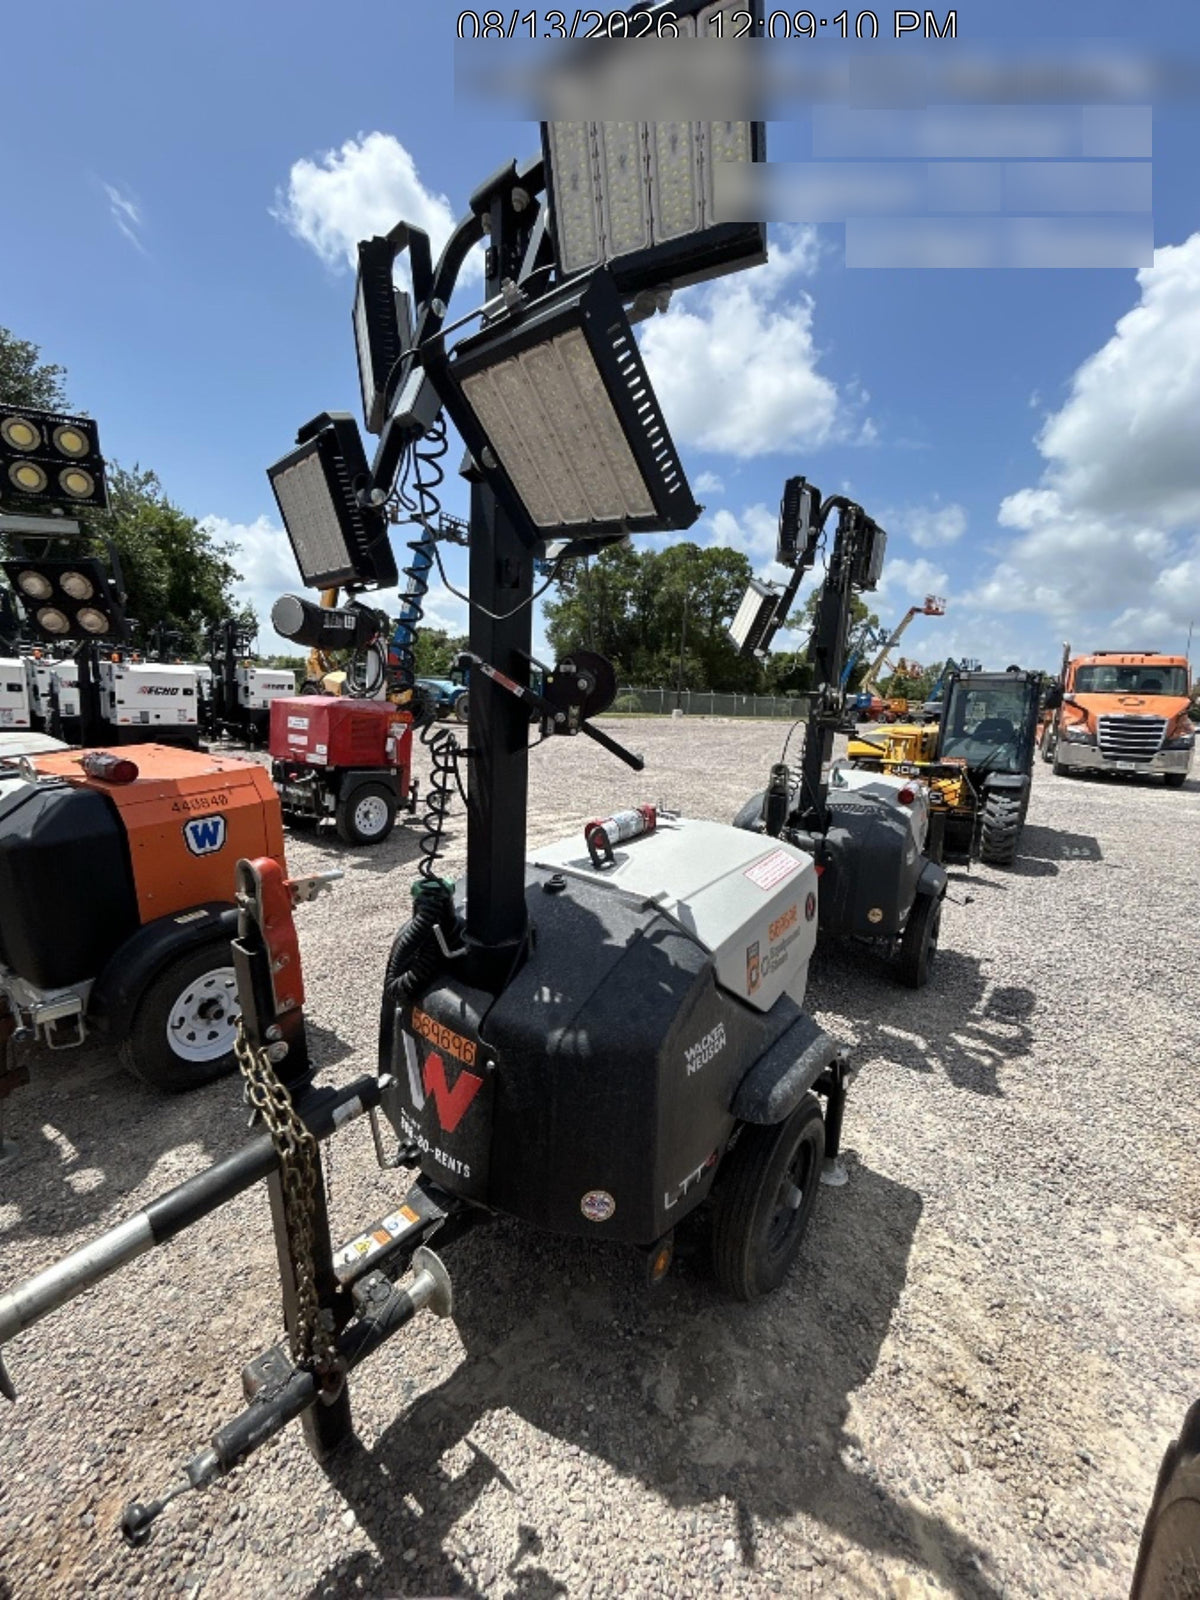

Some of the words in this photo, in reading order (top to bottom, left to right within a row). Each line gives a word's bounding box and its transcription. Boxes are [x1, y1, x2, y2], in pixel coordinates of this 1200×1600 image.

[189, 820, 221, 849] W
[684, 1022, 725, 1062] WACKER
[686, 1033, 727, 1076] NEUSON
